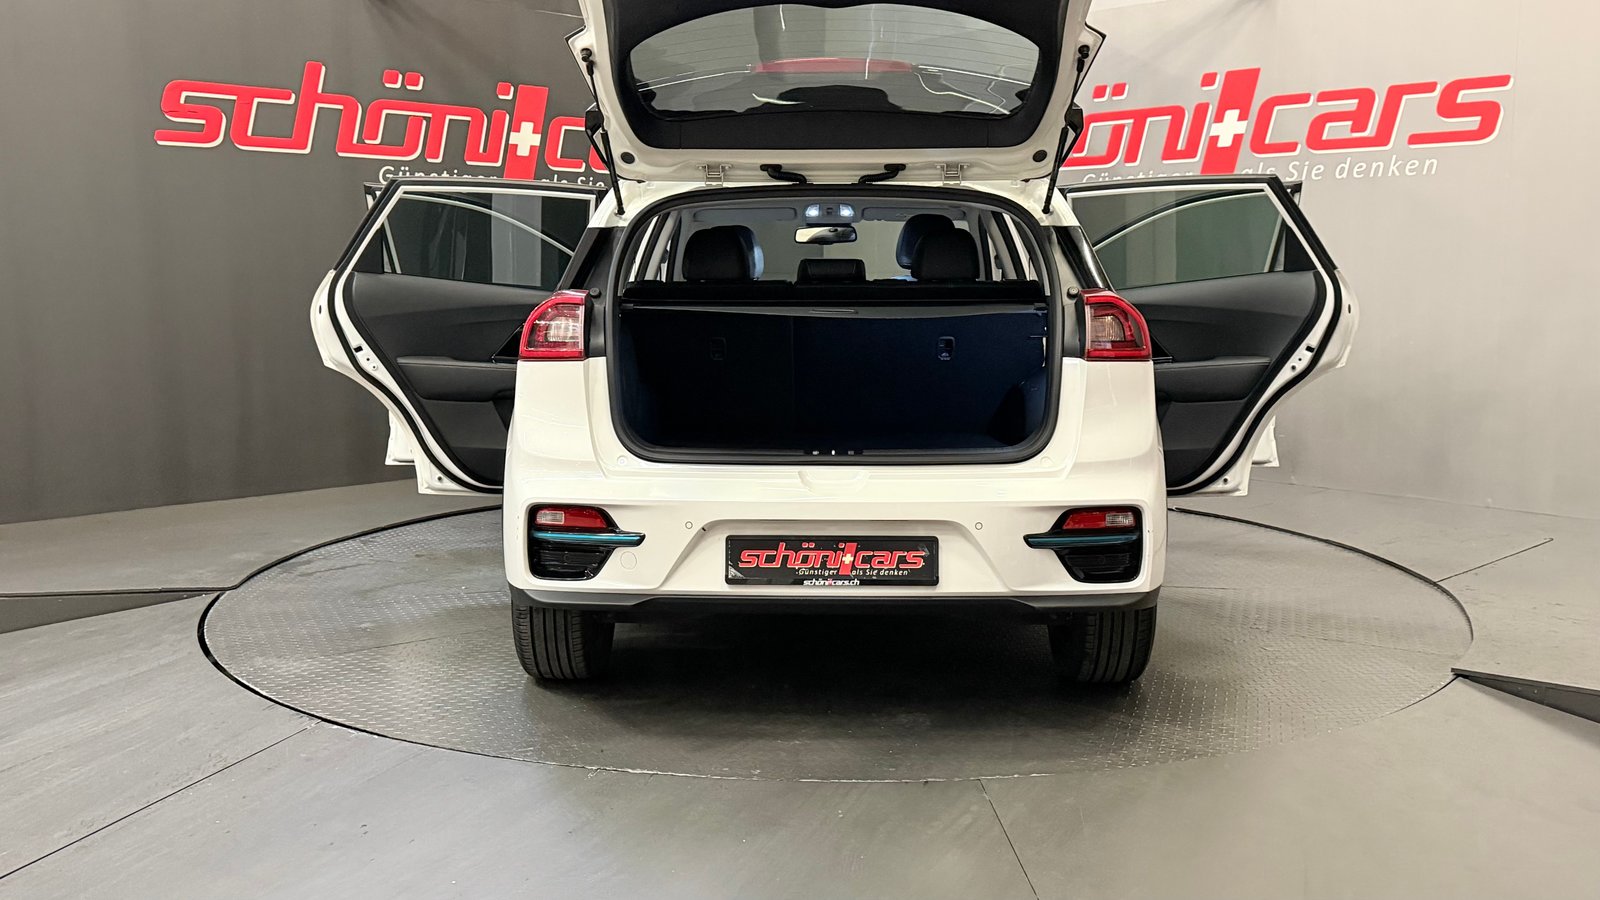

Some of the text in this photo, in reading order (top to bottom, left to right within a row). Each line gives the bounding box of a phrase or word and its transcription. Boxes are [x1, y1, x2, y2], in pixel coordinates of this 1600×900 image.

[1286, 161, 1323, 181] Sie
[1335, 155, 1439, 179] denken
[799, 568, 837, 576] Günstiger
